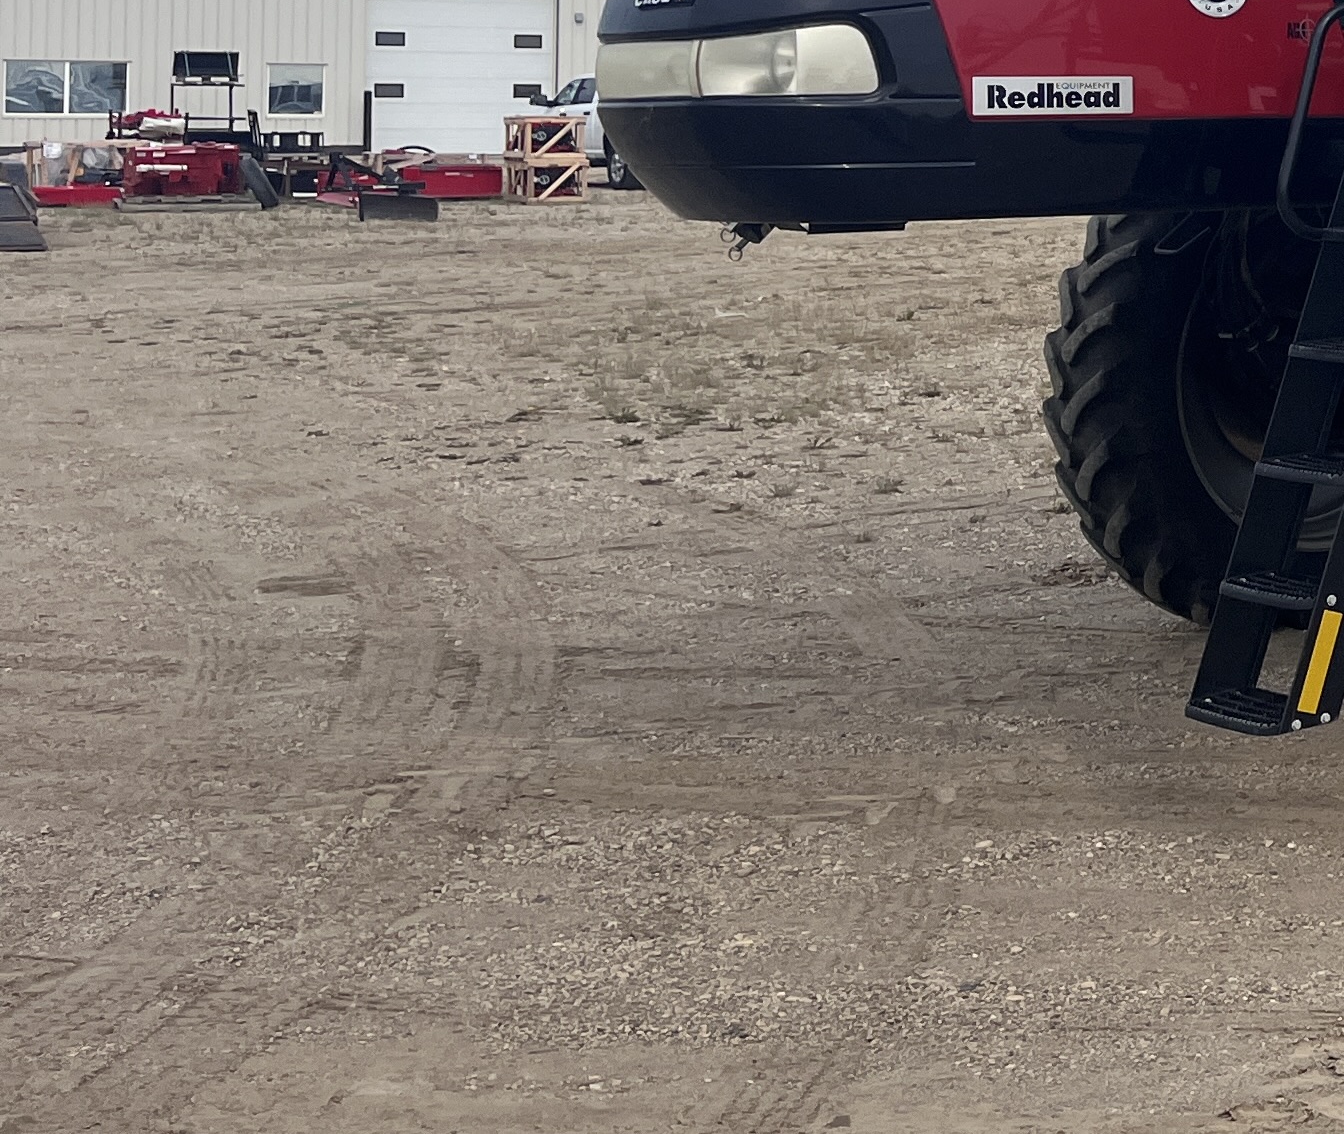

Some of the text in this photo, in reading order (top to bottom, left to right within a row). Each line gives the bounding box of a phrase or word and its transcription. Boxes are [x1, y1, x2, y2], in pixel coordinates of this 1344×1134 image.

[1203, 3, 1235, 13] USA
[1055, 82, 1110, 90] EQUIPMENT
[987, 82, 1120, 109] Redhead
